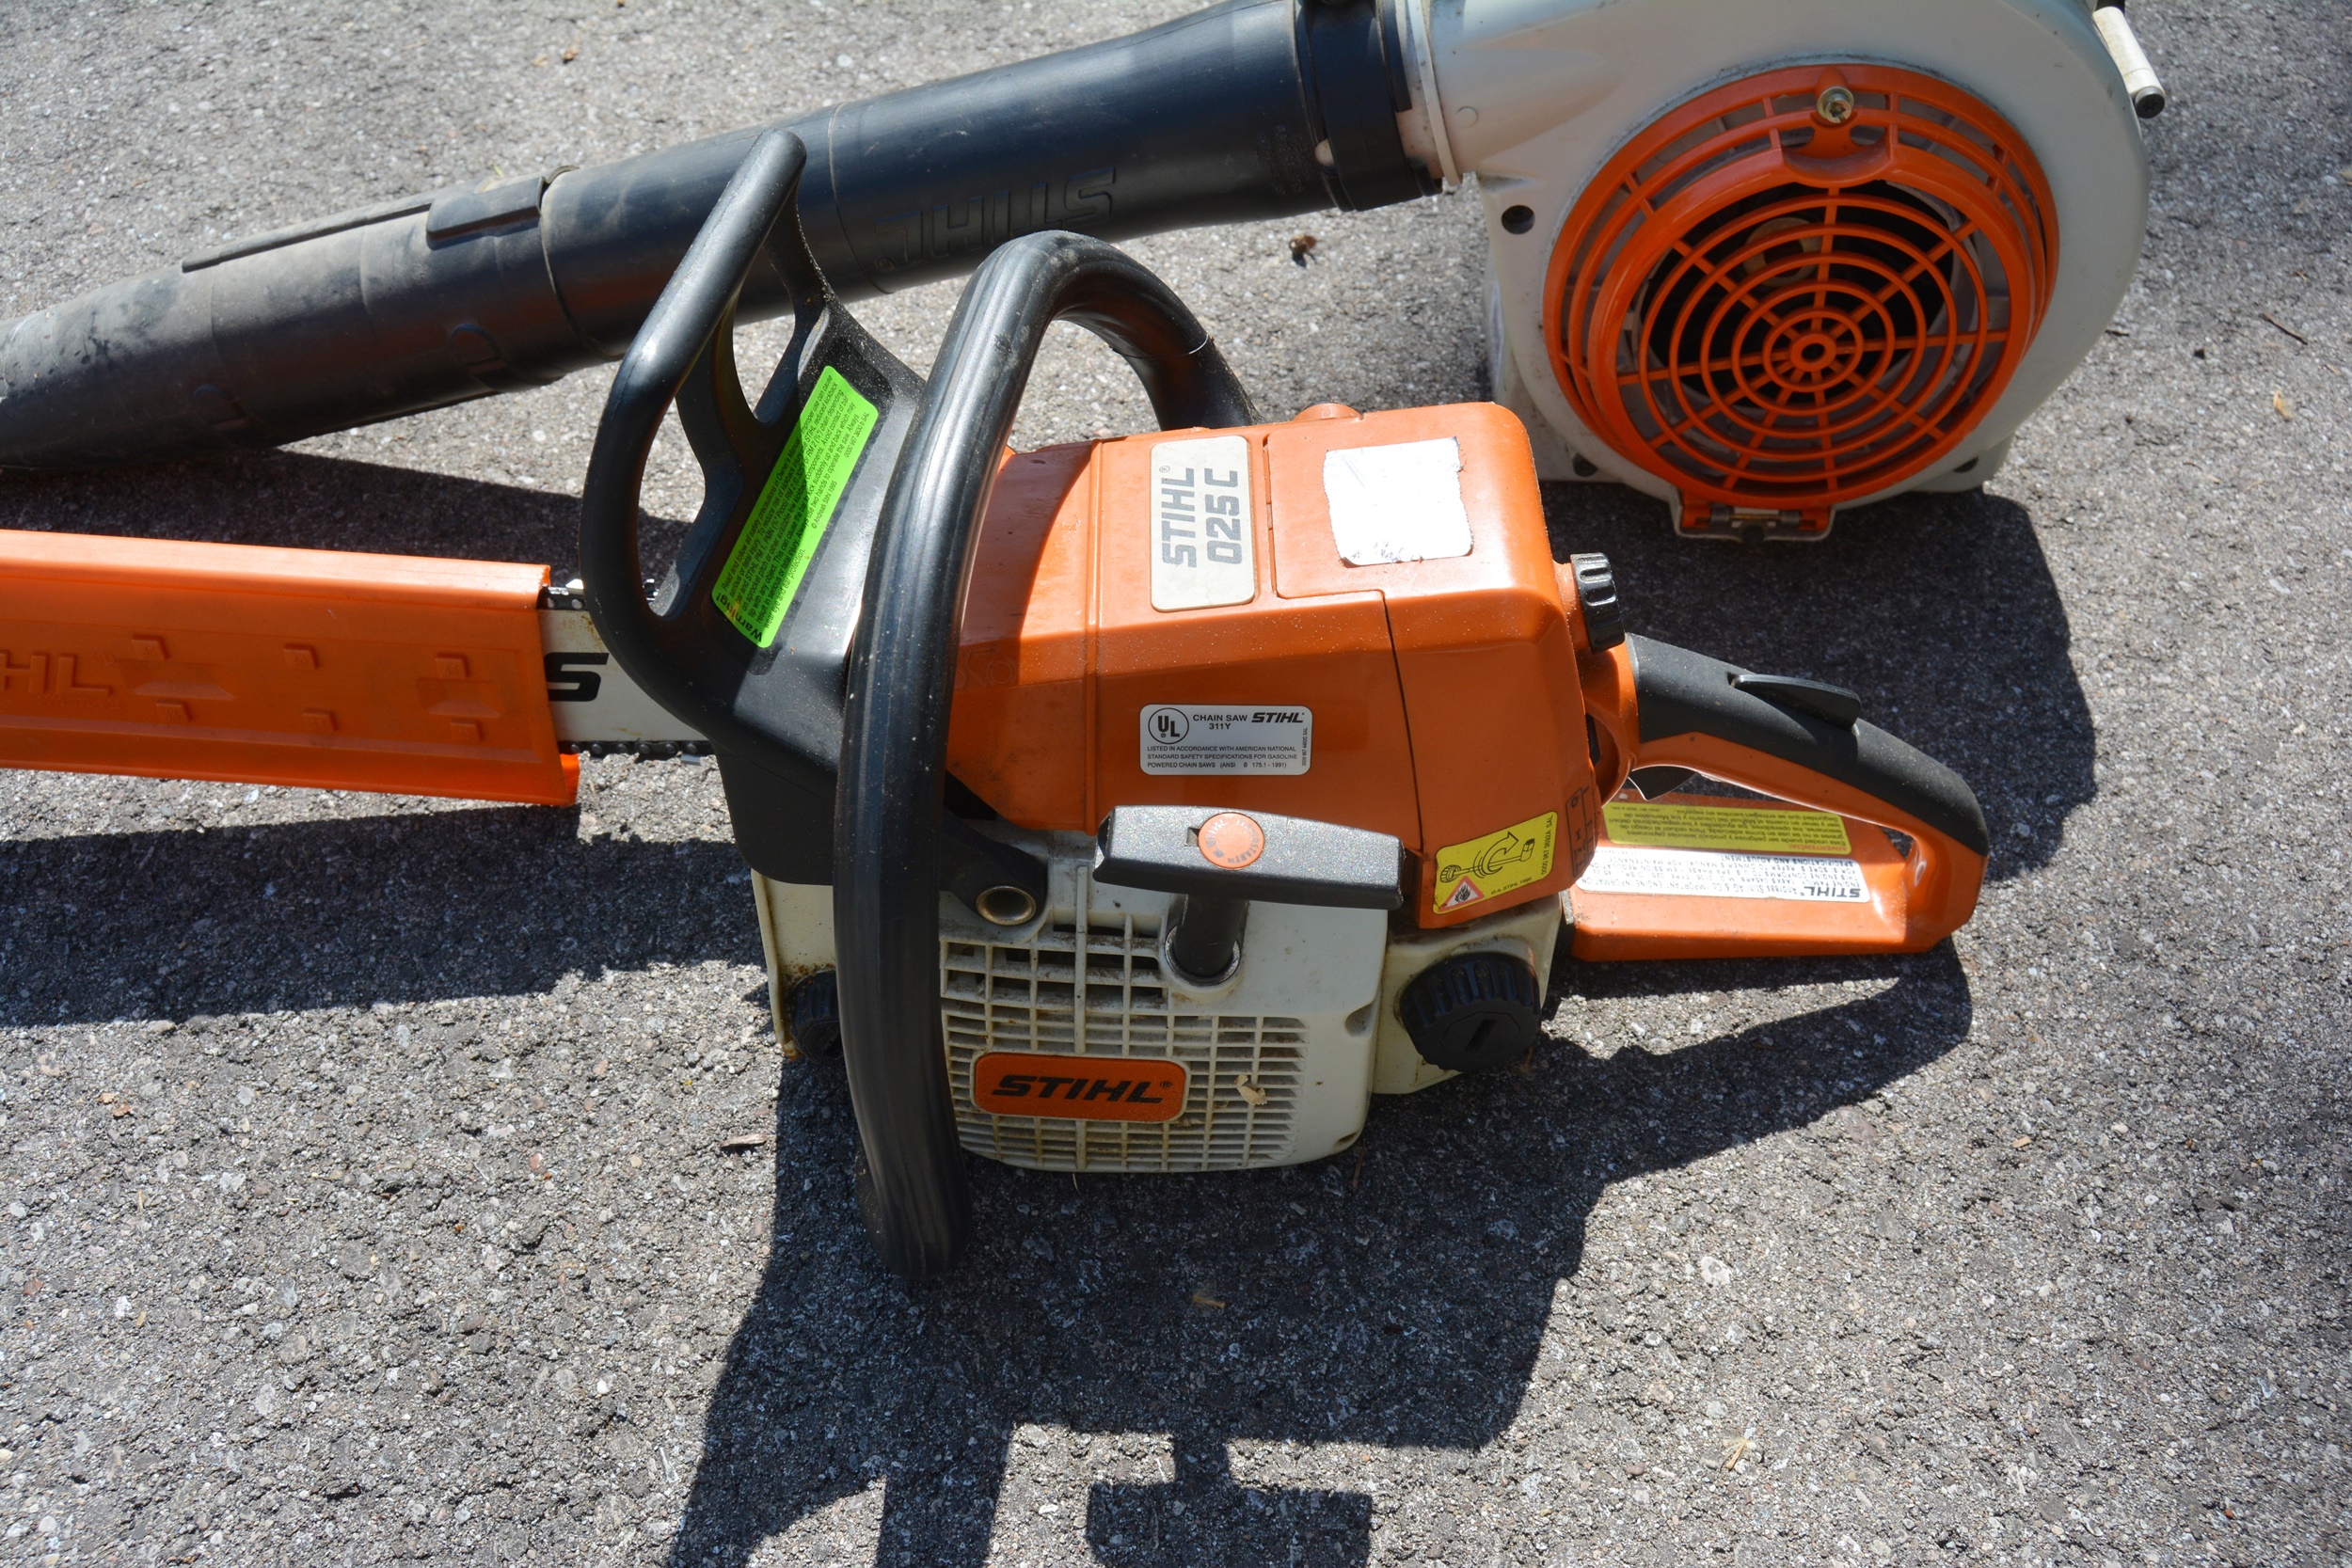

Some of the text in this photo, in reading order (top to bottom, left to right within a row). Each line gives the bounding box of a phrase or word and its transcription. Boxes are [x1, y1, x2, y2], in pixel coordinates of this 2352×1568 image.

[875, 166, 1115, 264] STIHL
[847, 402, 856, 415] may
[839, 412, 849, 429] which
[832, 427, 842, 442] back
[827, 440, 835, 452] and
[843, 444, 852, 457] 0000
[824, 451, 832, 461] up
[811, 459, 828, 485] suddenly
[721, 572, 733, 591] Read
[730, 560, 739, 574] and
[736, 543, 747, 561] follow
[756, 485, 777, 519] precautions
[775, 457, 790, 480] Owner's
[787, 436, 800, 457] Manual
[822, 374, 832, 391] cause
[728, 381, 837, 596] serious fatal reduce risk kickback STIHL reduced kickback
[805, 483, 815, 495] kick
[734, 389, 844, 604] bar and STIHL chain depending
[741, 395, 849, 611] on sprocket pitch or other available low kickback Avoid contact of bar
[798, 500, 806, 512] bar
[813, 502, 826, 523] Andreas
[822, 491, 831, 504] Stihl
[755, 412, 860, 623] result serious fatal Always use two hands operate the Always
[793, 510, 802, 521] the
[1162, 467, 1198, 567] STIHL
[1205, 468, 1243, 565] 025 C
[786, 521, 798, 539] cause
[780, 538, 788, 551] can
[772, 548, 784, 563] This
[758, 582, 769, 596] any
[782, 577, 790, 589] ear
[752, 594, 762, 608] with
[775, 587, 786, 601] and
[747, 608, 756, 617] tip
[771, 600, 781, 613] eye
[716, 593, 763, 642] Warning!
[763, 611, 773, 628] wear
[1250, 711, 1304, 722] STIHL
[1157, 715, 1180, 736] UL
[1545, 815, 1553, 828] SAL
[1205, 818, 1229, 847] STIHL
[1719, 854, 1771, 863] ADJUSTMENT
[1791, 858, 1852, 866] SPECIFICATIONS
[1764, 870, 1806, 879] CONFORMS
[1766, 885, 1797, 895] Andreas
[1804, 885, 1863, 898] STIHL
[992, 1073, 1164, 1104] STIHL
